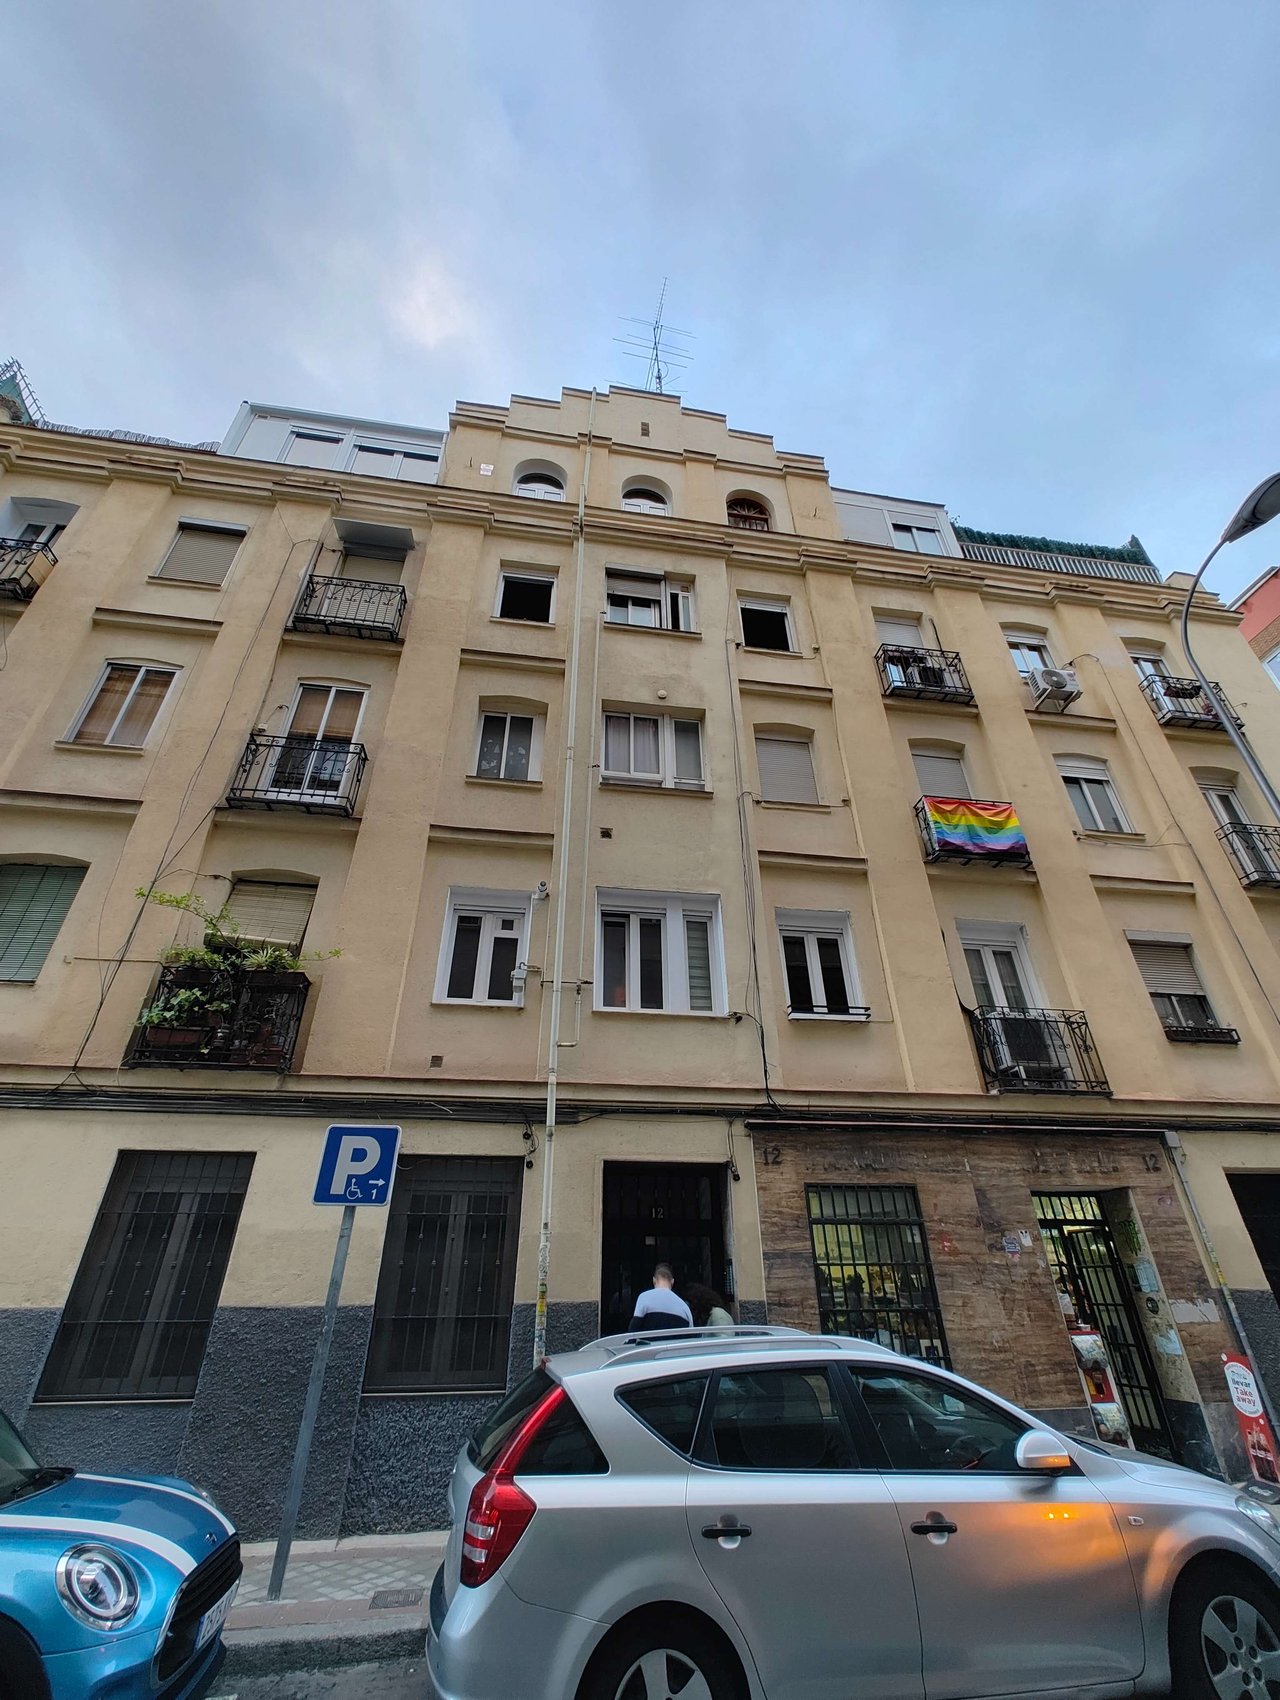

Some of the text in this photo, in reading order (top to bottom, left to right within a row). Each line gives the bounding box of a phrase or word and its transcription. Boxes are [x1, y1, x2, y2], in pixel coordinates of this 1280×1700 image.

[763, 1147, 783, 1166] 12
[1142, 1153, 1162, 1172] 12
[330, 1135, 381, 1195] P
[371, 1188, 377, 1200] 1
[652, 1207, 664, 1218] 12
[1234, 1386, 1254, 1398] Take
[1236, 1395, 1256, 1407] away
